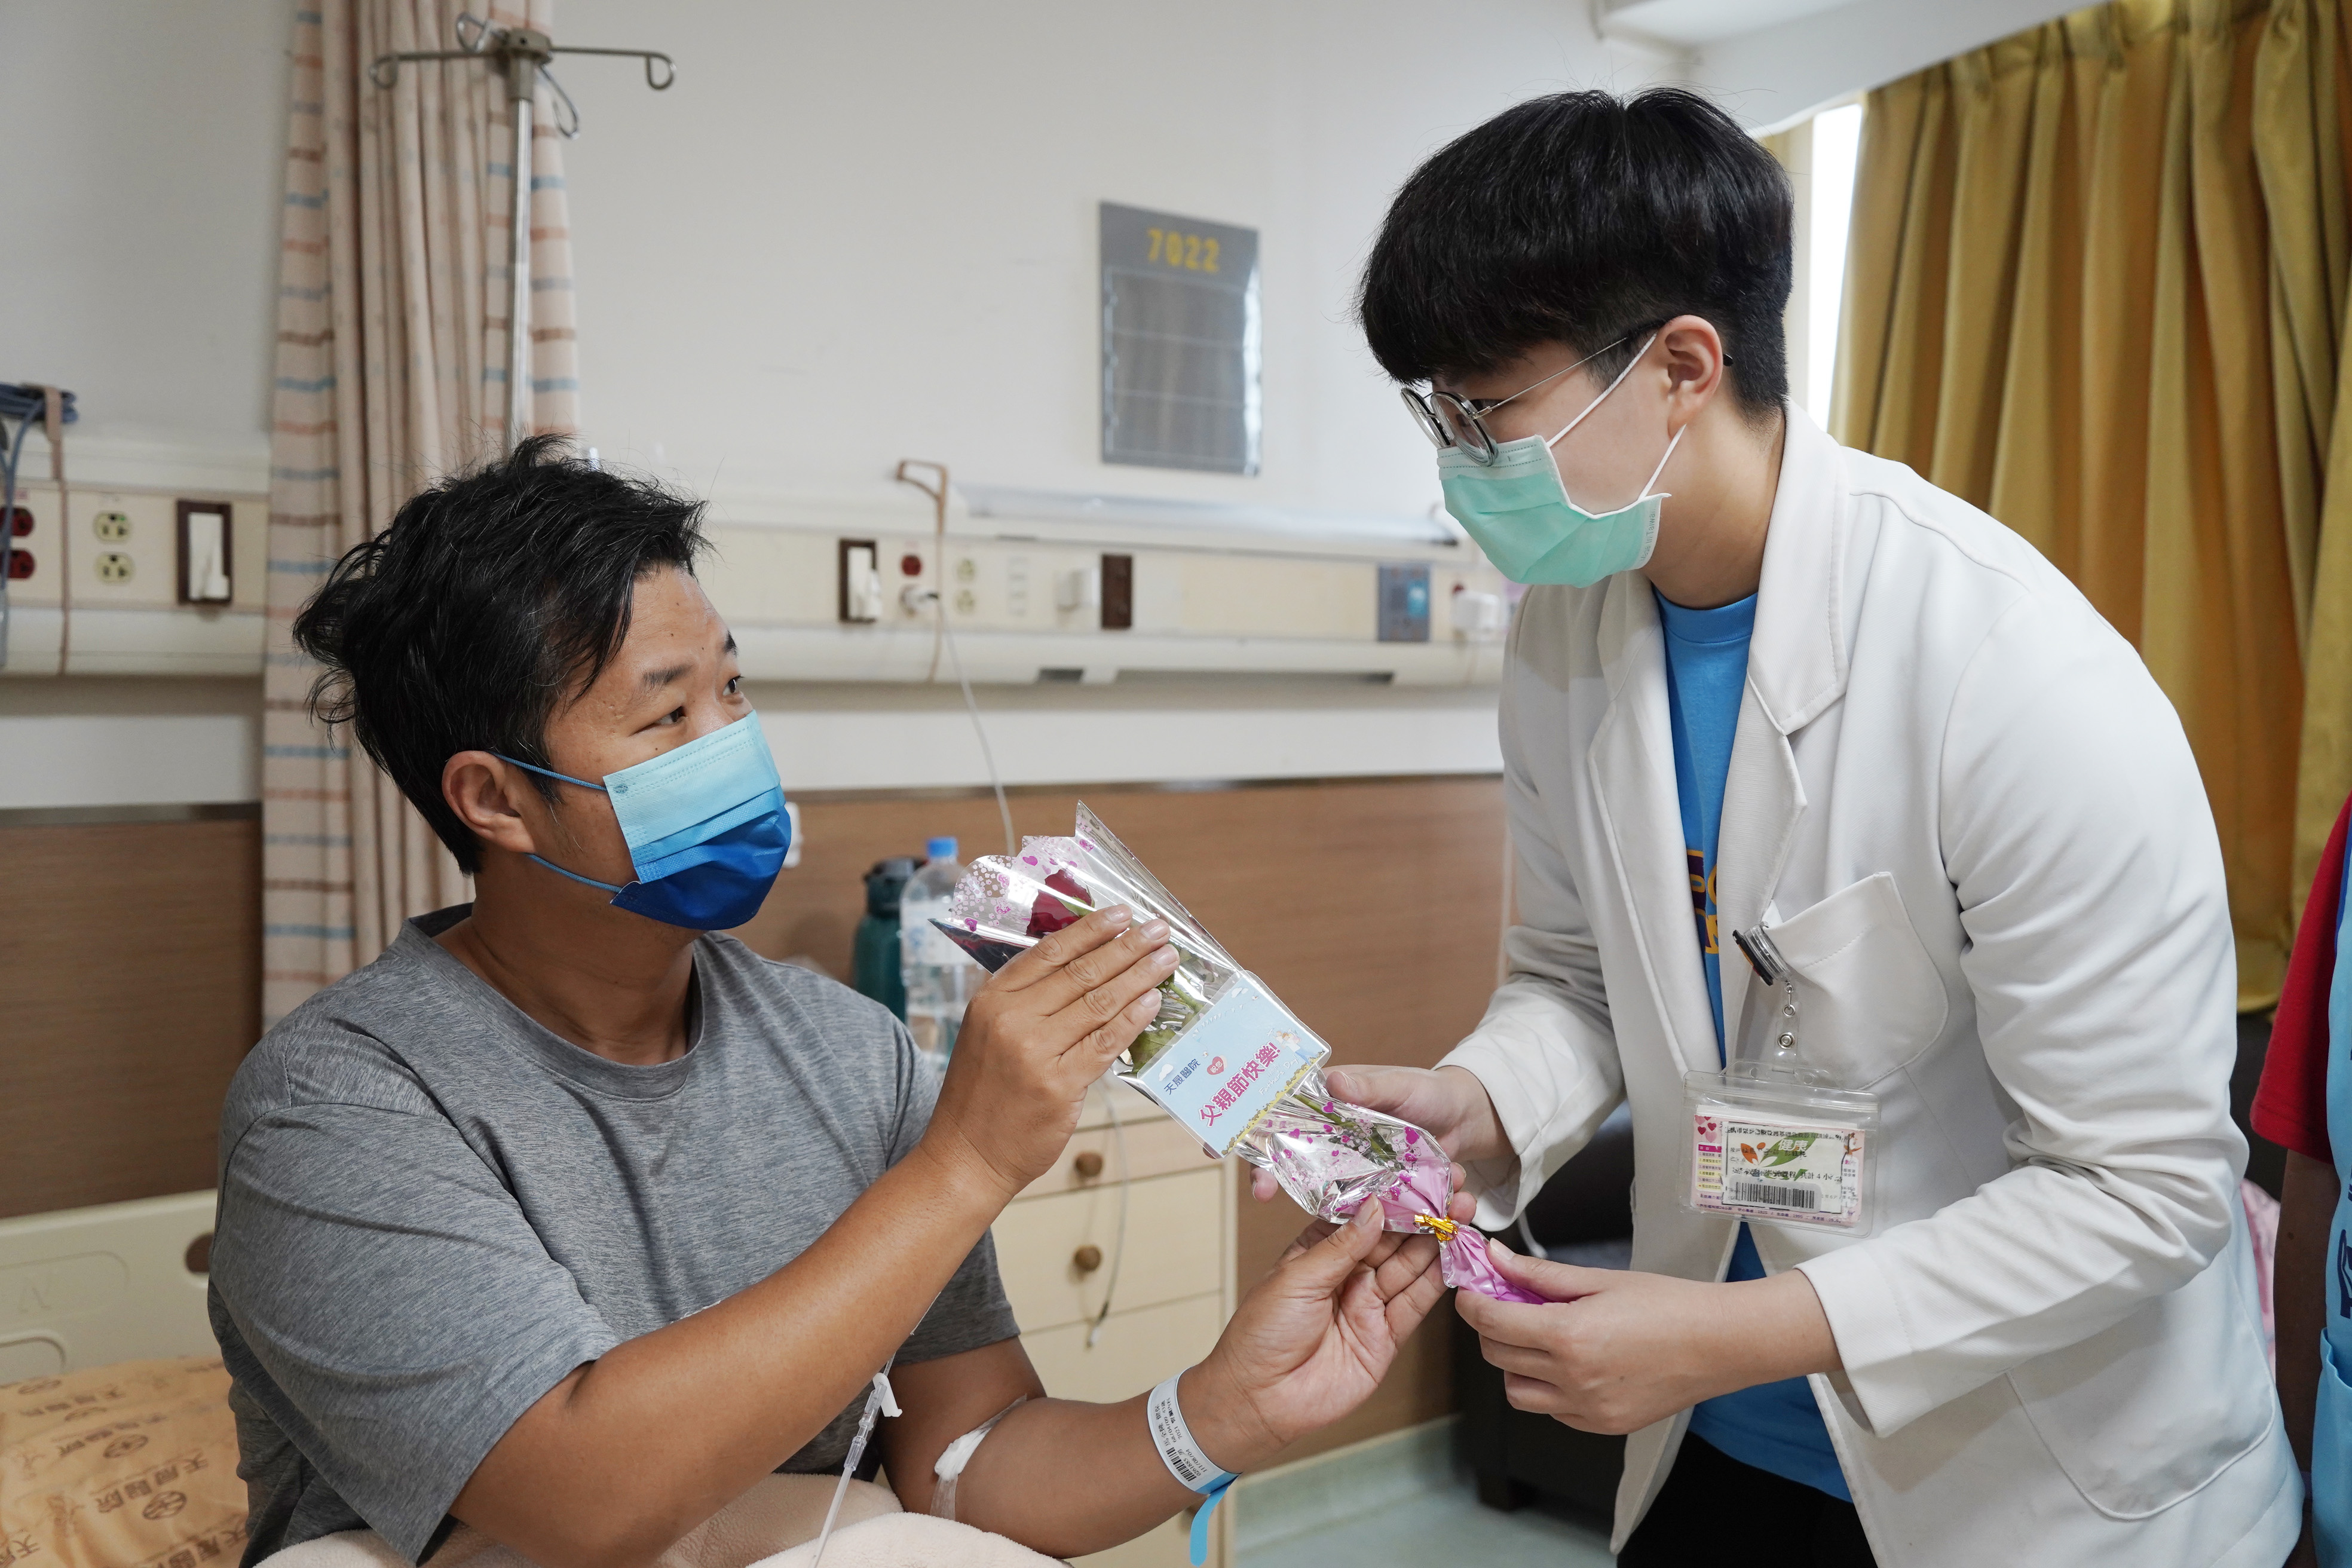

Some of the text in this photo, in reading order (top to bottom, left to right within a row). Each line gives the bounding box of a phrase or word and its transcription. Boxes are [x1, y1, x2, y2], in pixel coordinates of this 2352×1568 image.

[1147, 226, 1220, 274] 7022
[1164, 1058, 1201, 1095] 天晟醫院
[1209, 1061, 1223, 1074] 祝您
[1199, 1042, 1281, 1127] 父親節快樂!
[1258, 1070, 1285, 1095] Father's
[1777, 1139, 1808, 1152] 健康
[1174, 1426, 1183, 1440] 7021
